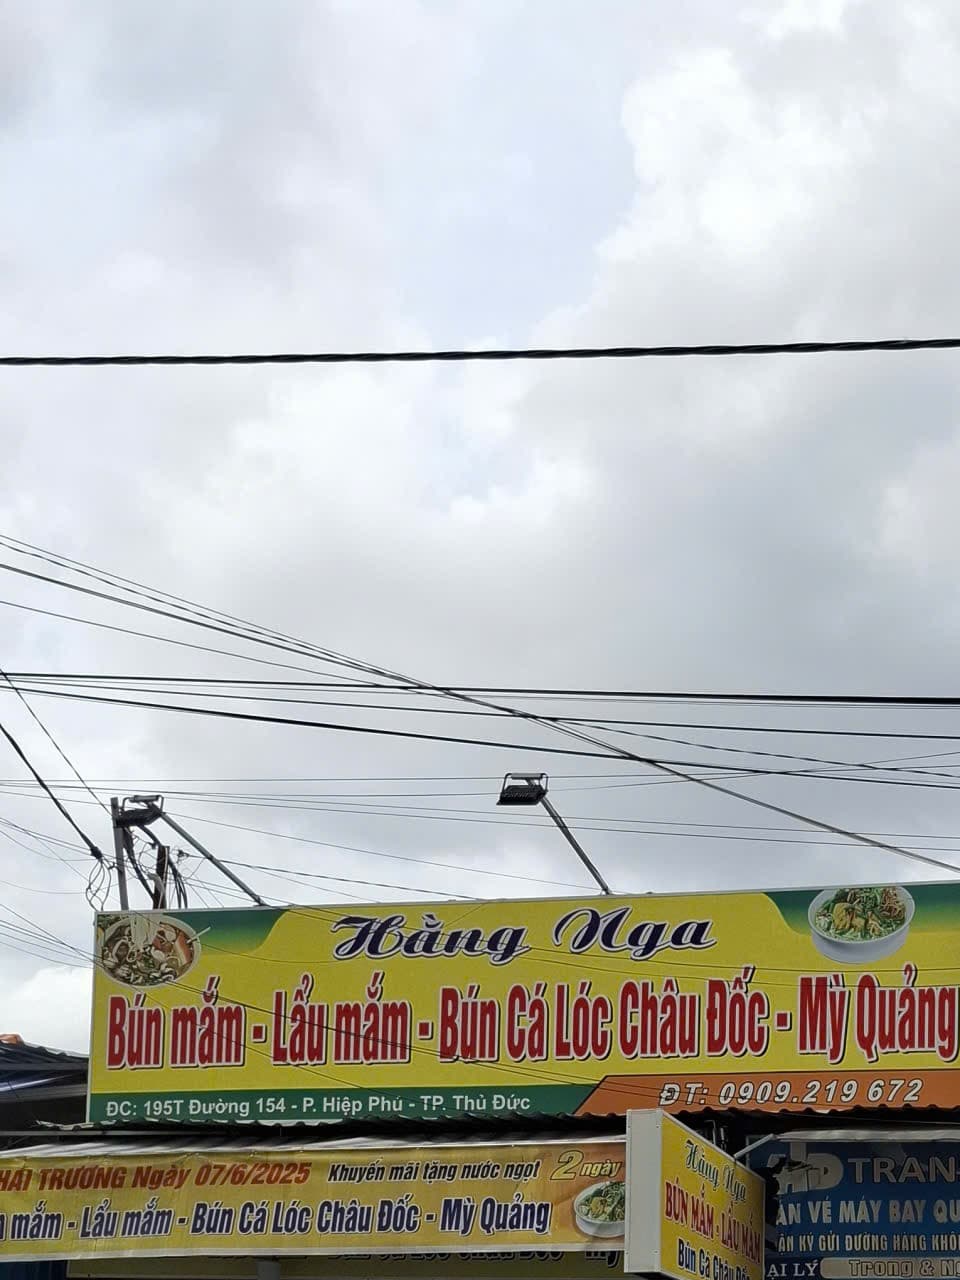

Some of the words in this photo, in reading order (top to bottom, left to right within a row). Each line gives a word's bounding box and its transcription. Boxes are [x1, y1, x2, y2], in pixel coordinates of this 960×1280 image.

[330, 912, 530, 966] Hằng
[551, 905, 718, 961] Nga
[107, 991, 166, 1069] Bún
[170, 974, 247, 1068] mắm
[272, 973, 328, 1066] Lẩu
[334, 970, 411, 1063] mắm
[439, 984, 501, 1063] Bún
[506, 979, 548, 1061] Cá
[554, 979, 612, 1060] Lóc
[618, 976, 700, 1060] Châu
[705, 965, 769, 1057] Đốc
[798, 972, 850, 1064] Mỳ
[856, 964, 960, 1063] Quảng
[106, 1101, 137, 1117] ĐC:
[144, 1099, 184, 1116] 195T
[189, 1098, 250, 1117] Đường
[256, 1097, 286, 1113] 154
[302, 1097, 317, 1113] P.
[322, 1096, 363, 1116] Hiệp
[368, 1096, 403, 1112] Phú
[420, 1095, 446, 1111] TP.
[452, 1094, 487, 1110] Thủ
[492, 1093, 531, 1110] Đức
[659, 1082, 709, 1106] ĐT:
[718, 1079, 858, 1106] 0909.219
[867, 1078, 925, 1103] 672
[38, 1165, 128, 1191] TRƯƠNG
[131, 1165, 192, 1190] Ngày
[194, 1162, 311, 1186] 07/6/2025
[328, 1156, 384, 1183] Khuyến
[388, 1161, 419, 1181] mãi
[423, 1159, 457, 1183] tặng
[459, 1160, 500, 1180] nước
[502, 1159, 540, 1182] ngọt
[550, 1149, 584, 1180] 2
[580, 1159, 623, 1178] ngày
[665, 1177, 688, 1224] BÚN
[776, 1198, 801, 1225] ÁN
[808, 1195, 832, 1223] VÉ
[839, 1195, 882, 1223] MÁY
[889, 1199, 924, 1223] BAY
[10, 1200, 63, 1240] mắm
[79, 1199, 119, 1239] Lẩu
[121, 1196, 174, 1237] mắm
[190, 1202, 233, 1235] Bún
[238, 1201, 270, 1234] Cá
[271, 1201, 312, 1234] Lóc
[316, 1197, 371, 1234] Châu
[376, 1193, 419, 1234] Đốc
[439, 1196, 475, 1236] Mỳ
[480, 1192, 551, 1235] Quảng
[677, 1237, 696, 1274] Bún
[699, 1248, 710, 1279] Cá
[778, 1233, 794, 1255] ẬN
[799, 1232, 814, 1252] KÝ
[767, 1263, 787, 1280] ẠI
[793, 1259, 819, 1277] LÝ
[849, 1259, 913, 1277] Trong
[919, 1260, 934, 1276] &
